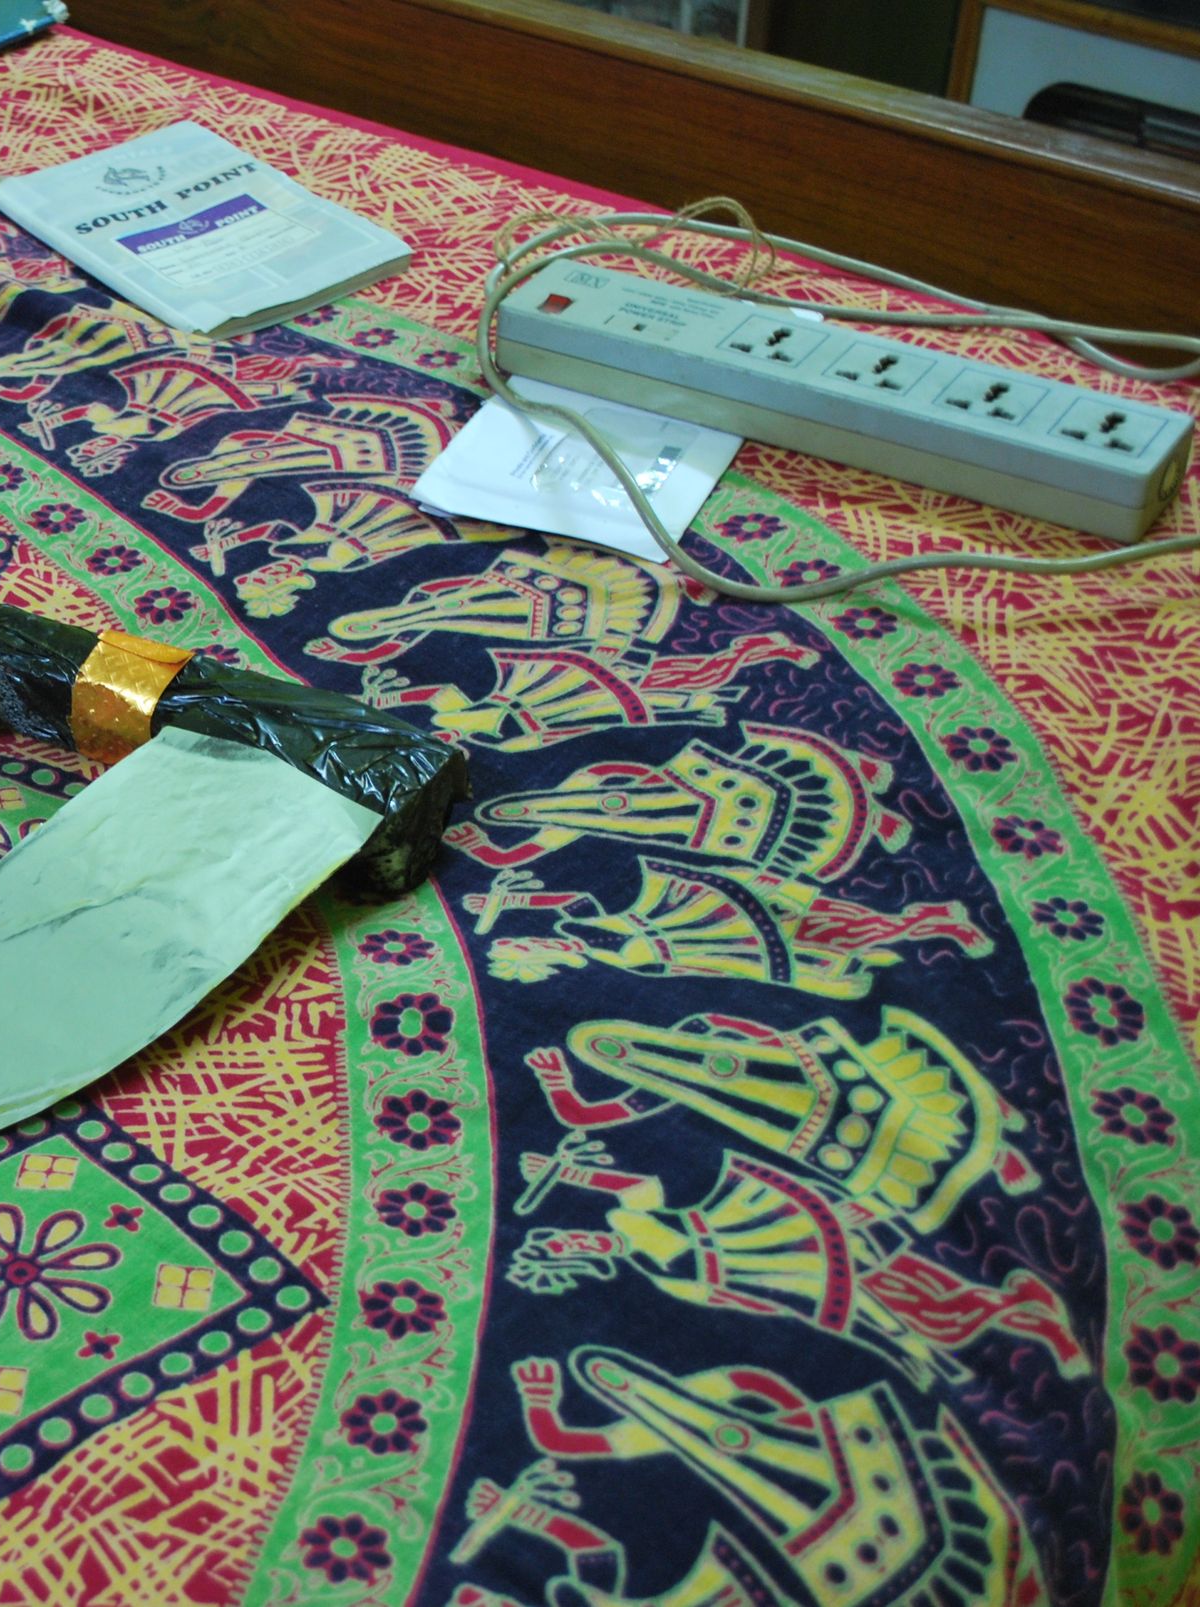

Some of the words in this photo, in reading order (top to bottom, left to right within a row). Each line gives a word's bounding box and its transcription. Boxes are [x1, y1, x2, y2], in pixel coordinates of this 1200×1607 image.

[75, 199, 168, 235] SOUTH
[175, 162, 257, 200] POINT
[137, 234, 187, 254] SOUTH
[214, 206, 259, 228] POINT
